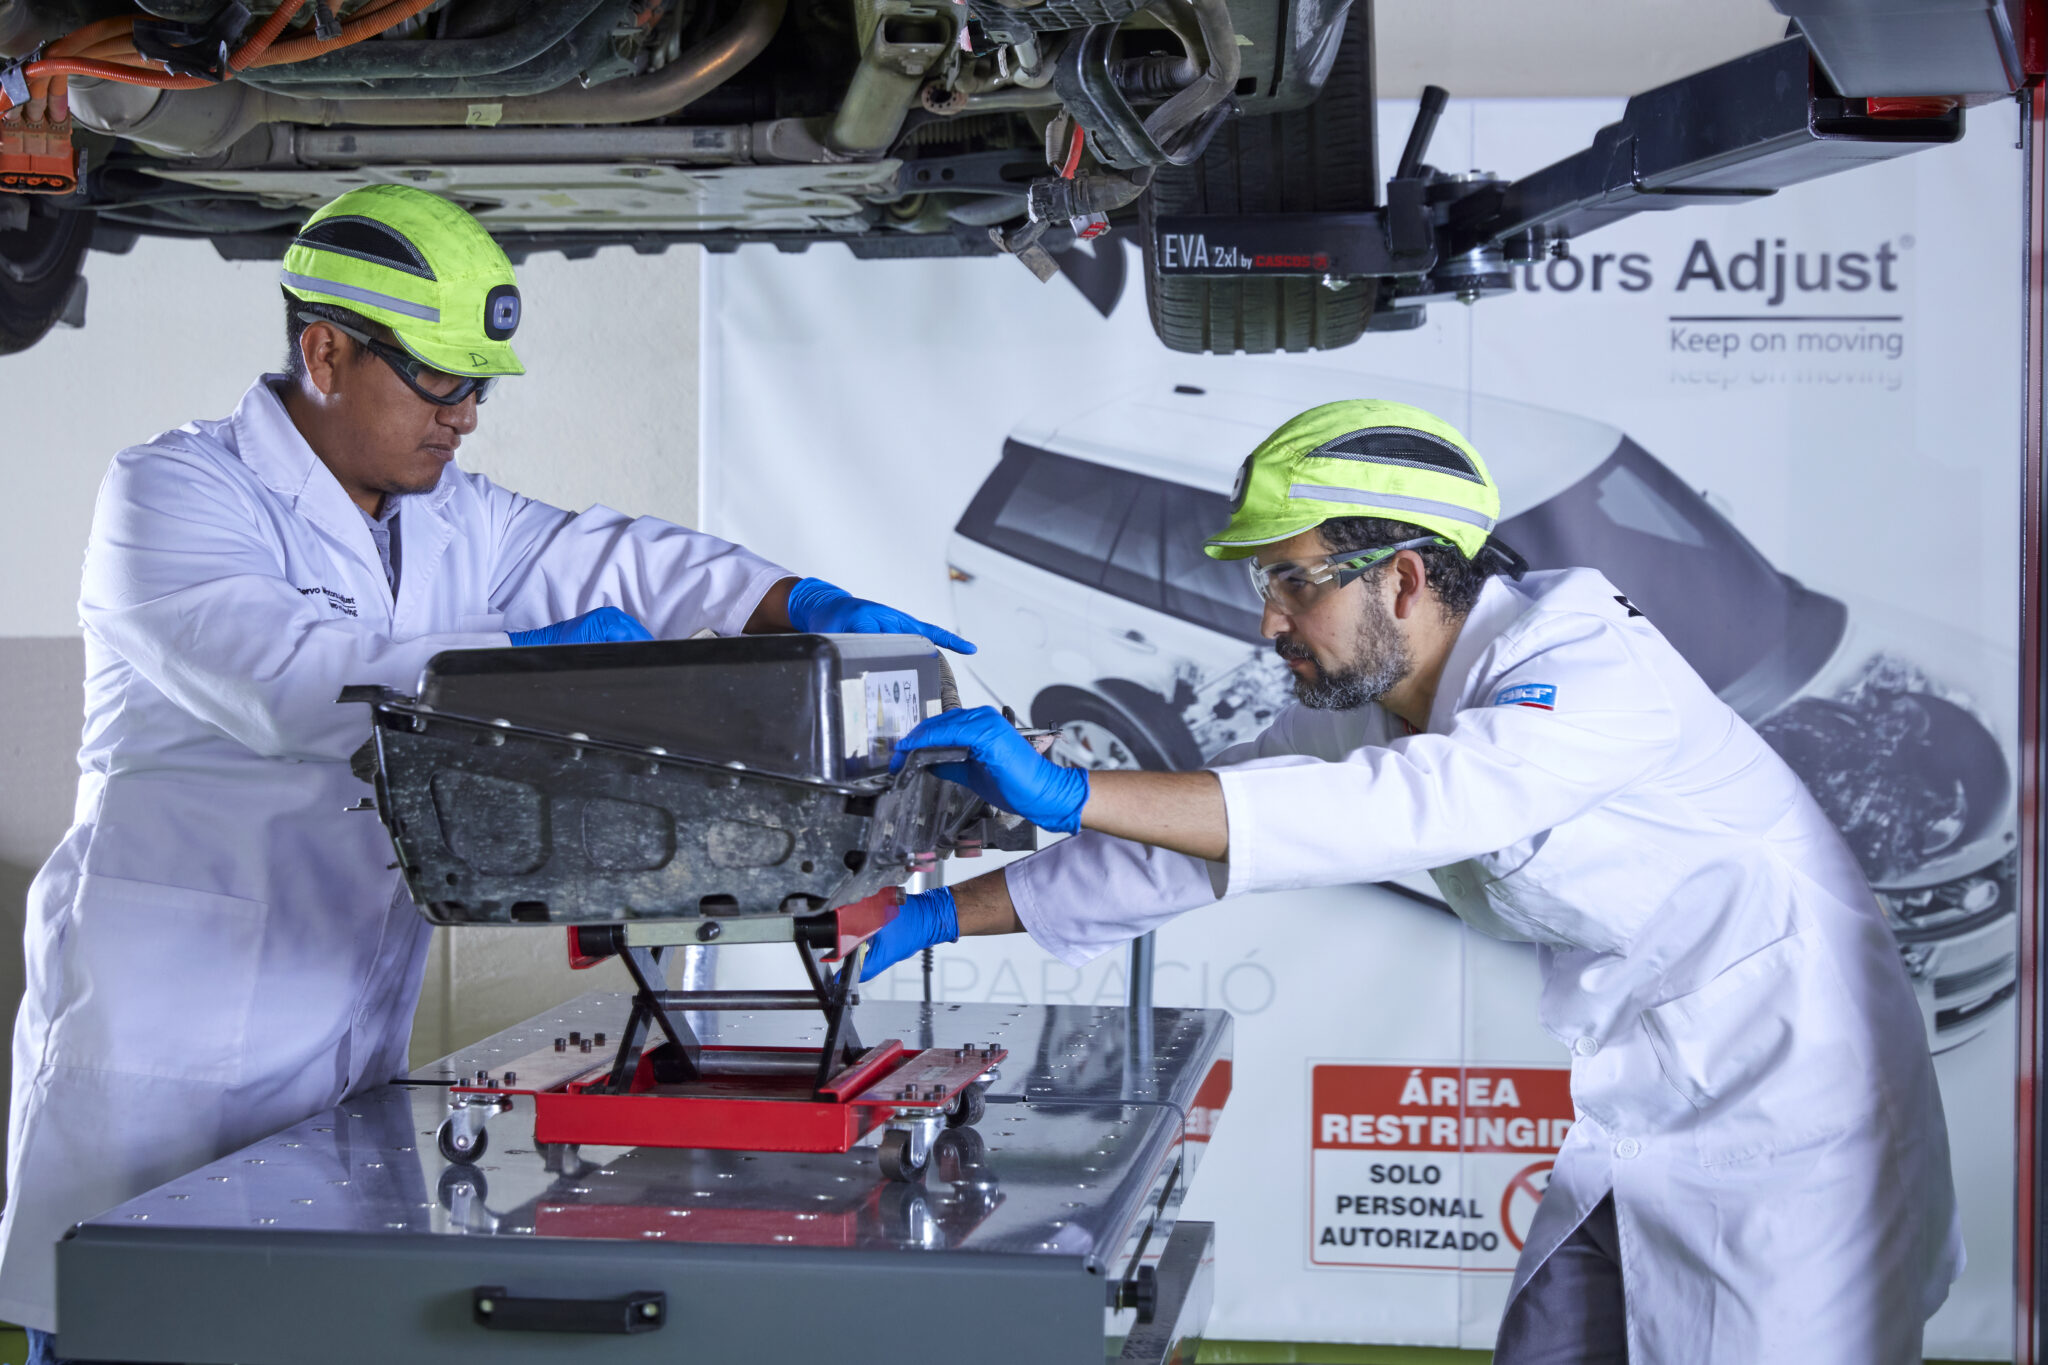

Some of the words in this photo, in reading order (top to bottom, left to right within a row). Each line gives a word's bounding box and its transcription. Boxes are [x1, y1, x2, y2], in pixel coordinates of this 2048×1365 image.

[1165, 234, 1209, 268] EVA
[1241, 254, 1252, 270] by
[1256, 255, 1311, 268] CASCOS
[1508, 248, 1653, 293] tors
[1675, 238, 1899, 306] Adjust
[1670, 327, 1740, 358] Keep
[1750, 334, 1787, 352] on
[1797, 326, 1903, 359] moving
[469, 353, 488, 367] D
[1399, 1068, 1521, 1108] ÁREA
[1321, 1113, 1574, 1148] RESTRINGID
[1370, 1163, 1441, 1185] SOLO
[1336, 1195, 1484, 1219] PERSONAL
[1319, 1226, 1499, 1252] AUTORIZADO
